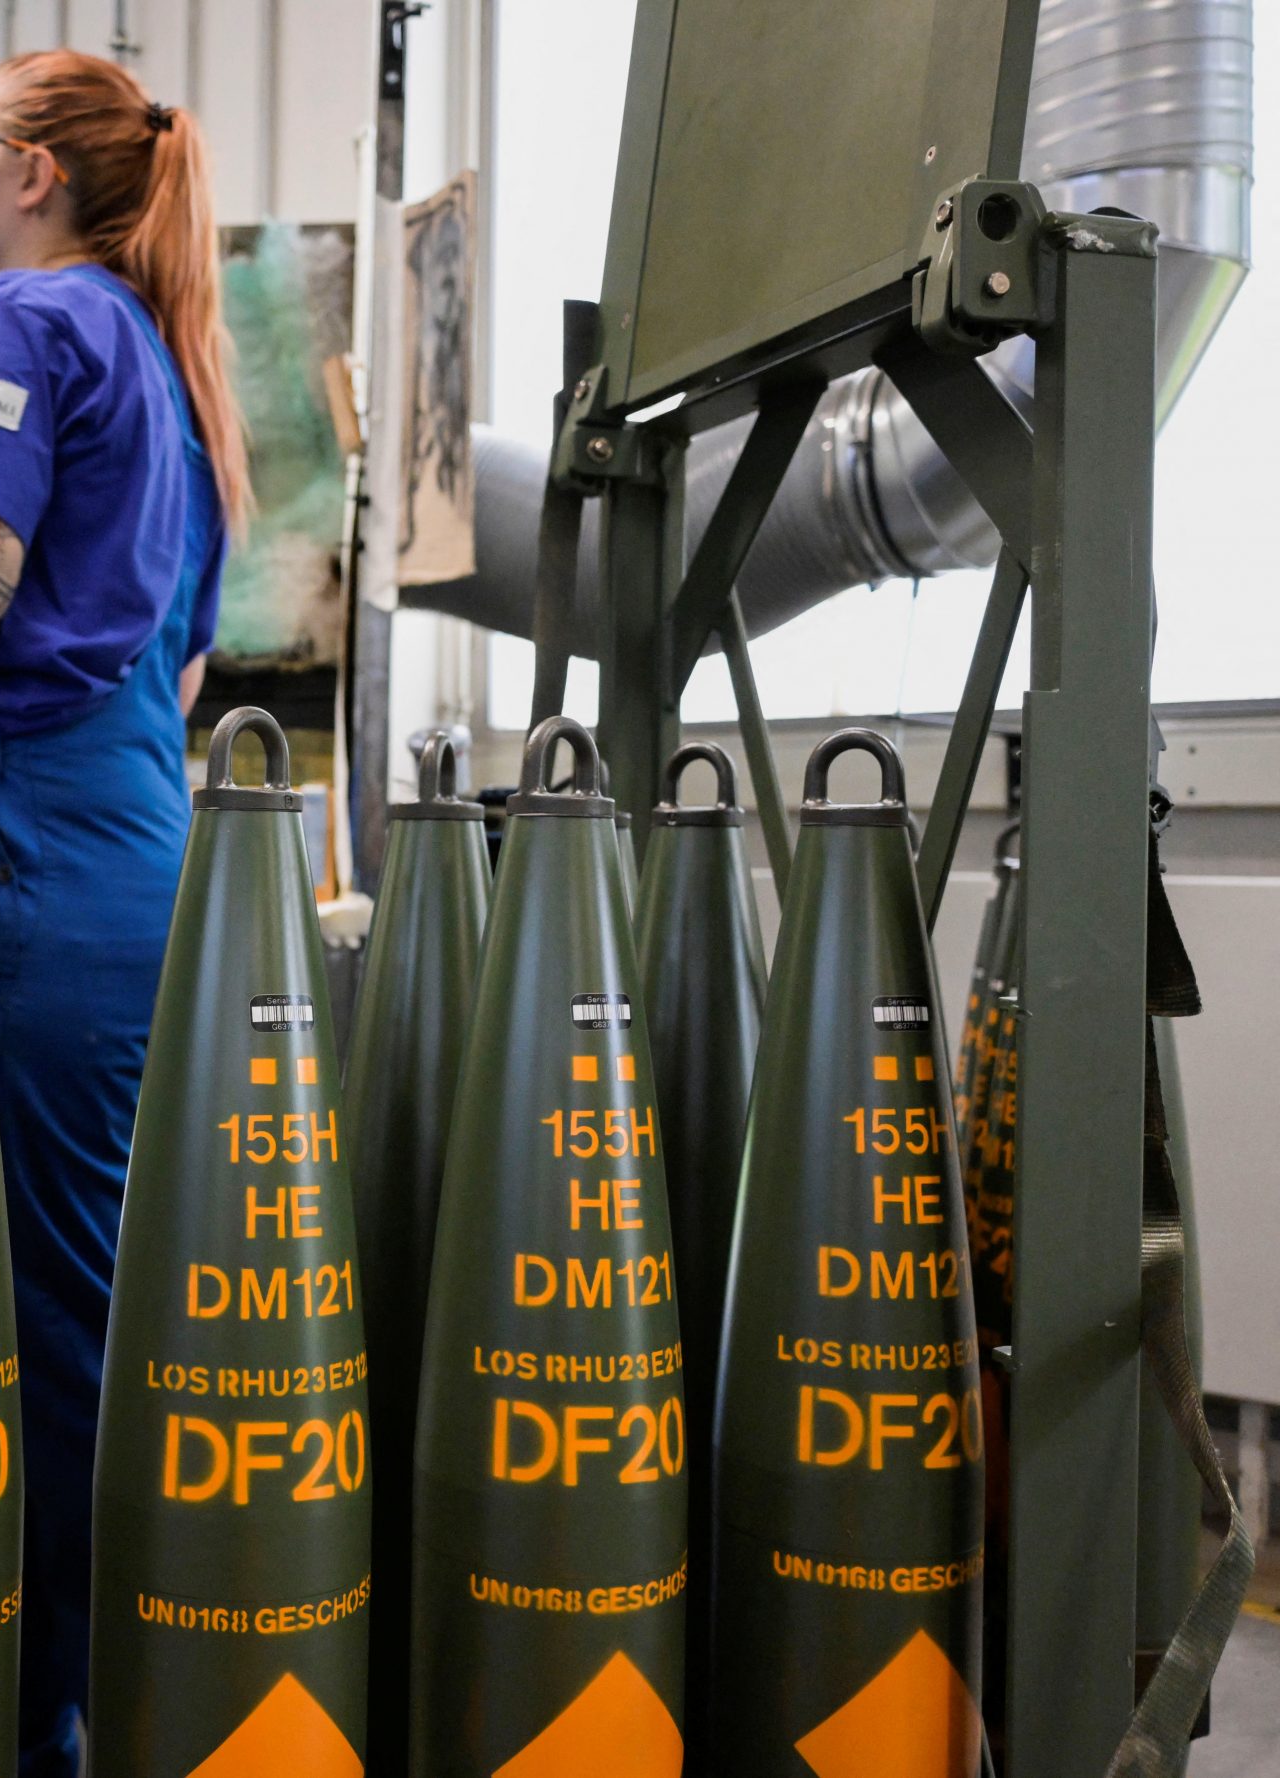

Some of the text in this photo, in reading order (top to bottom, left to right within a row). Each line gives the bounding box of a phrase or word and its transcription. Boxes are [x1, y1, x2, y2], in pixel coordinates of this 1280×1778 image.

[220, 1110, 338, 1164] 155H
[542, 1107, 655, 1158] 155H
[842, 1106, 954, 1155] 155H
[246, 1186, 323, 1239] HE
[570, 1179, 643, 1231] HE
[874, 1176, 942, 1224] HE
[188, 1260, 352, 1320] DM121
[515, 1252, 671, 1308] DM121
[816, 1244, 971, 1300] DM121
[148, 1353, 367, 1397] LOS RHU23E212
[475, 1344, 682, 1382] LOS RHU23E21
[778, 1335, 976, 1371] LOS RHU23E
[492, 1397, 683, 1486] DF20
[798, 1385, 984, 1470] DF20
[163, 1411, 364, 1505] DF20
[586, 1564, 685, 1615] GESCHOS
[890, 1558, 982, 1592] GESCH
[254, 1580, 369, 1635] GESCHOS
